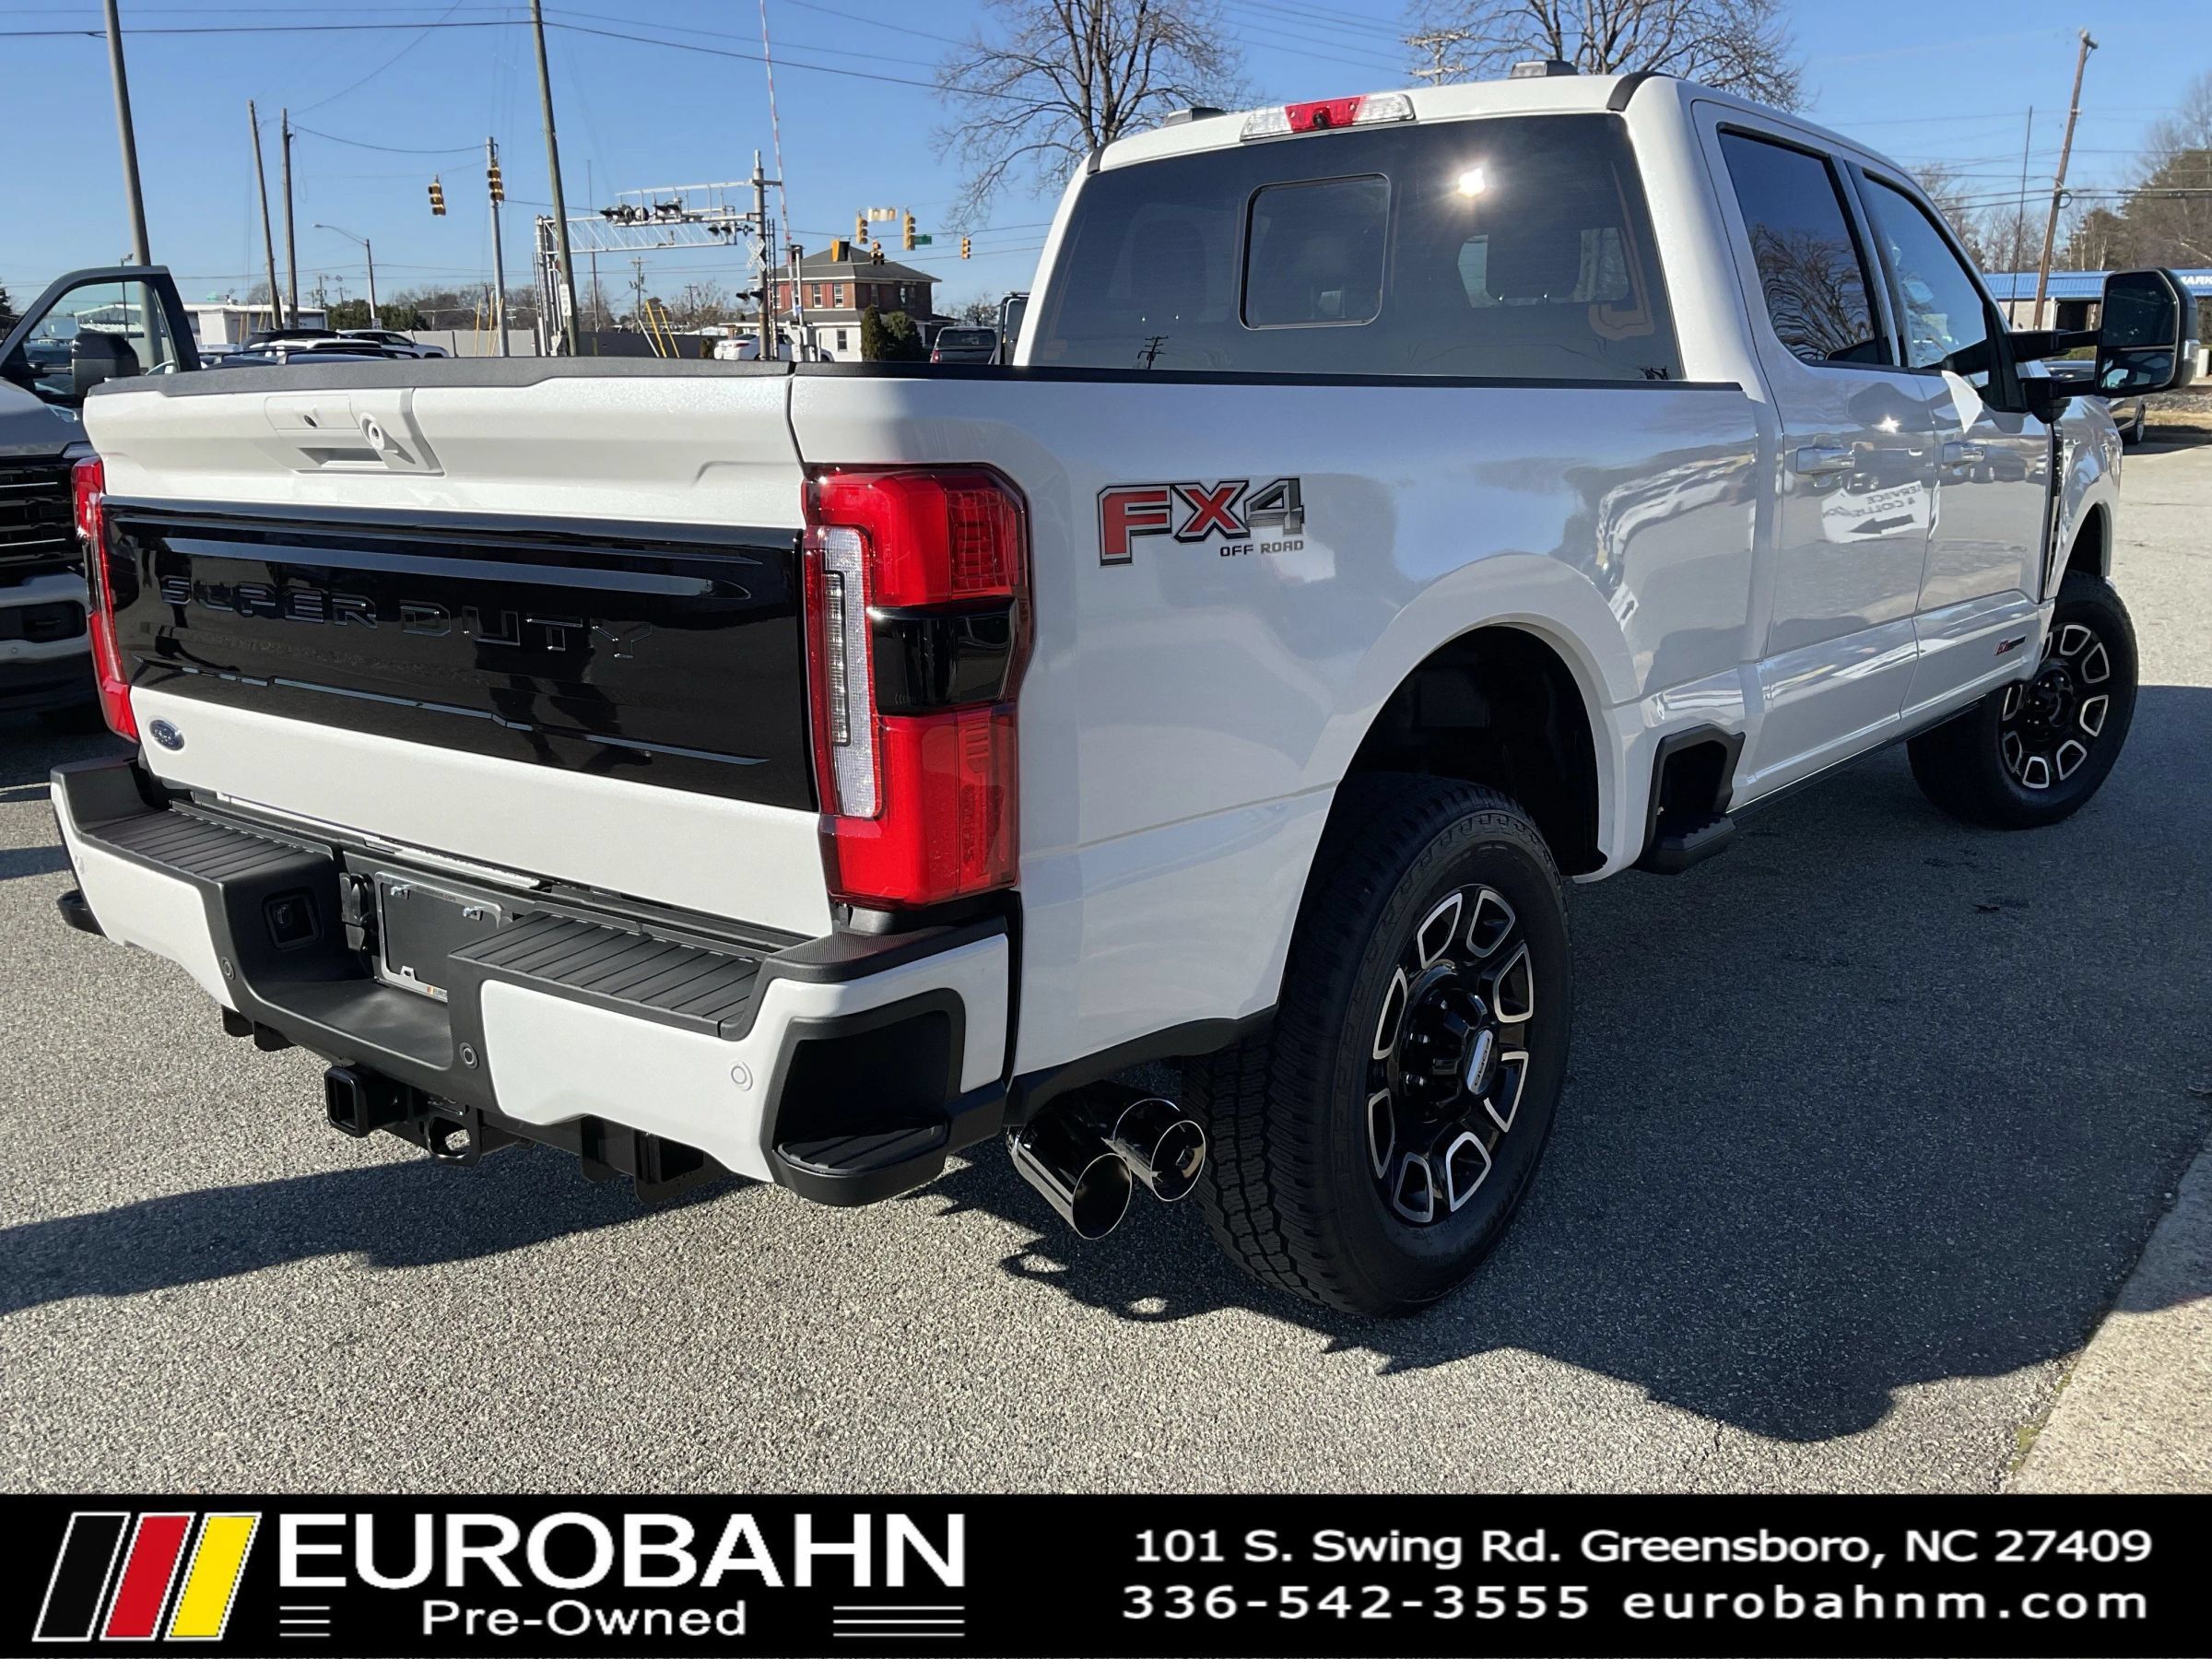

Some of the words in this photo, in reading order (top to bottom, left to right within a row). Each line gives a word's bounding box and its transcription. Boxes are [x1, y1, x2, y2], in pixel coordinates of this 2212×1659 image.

[1098, 477, 1305, 567] FX4
[1219, 545, 1254, 558] OFF
[1260, 539, 1305, 554] ROAD
[159, 575, 378, 630] SUPER
[398, 599, 654, 660] DUTY
